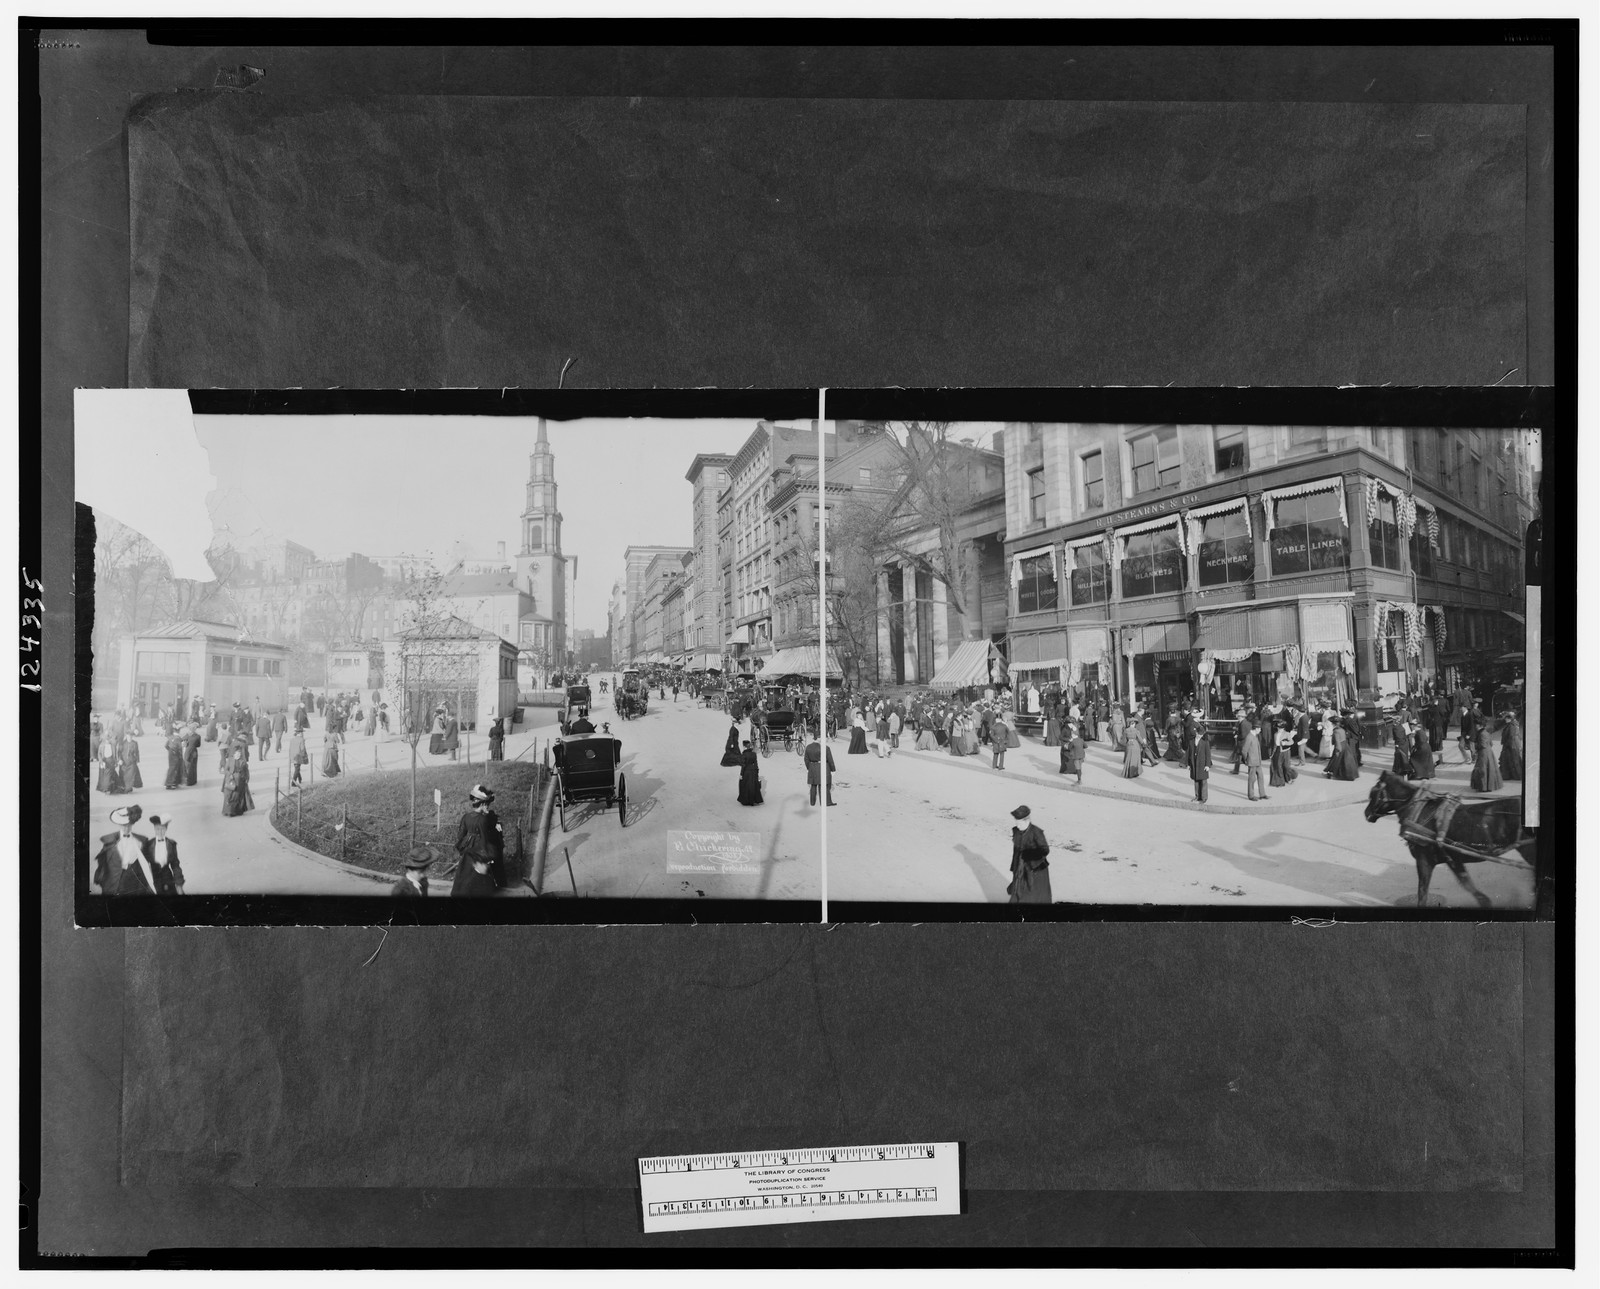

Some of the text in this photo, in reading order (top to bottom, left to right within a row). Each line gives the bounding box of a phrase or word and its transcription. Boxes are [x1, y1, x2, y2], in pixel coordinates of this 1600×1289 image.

[1117, 503, 1165, 521] STEARNS
[1169, 499, 1178, 509] &
[1276, 538, 1342, 556] TABLE LINEN
[1206, 554, 1249, 567] NECKWEAR
[1135, 567, 1173, 580] BLANKETS
[20, 566, 46, 693] 124335
[782, 1157, 787, 1165] 3
[879, 1152, 884, 1160] 5
